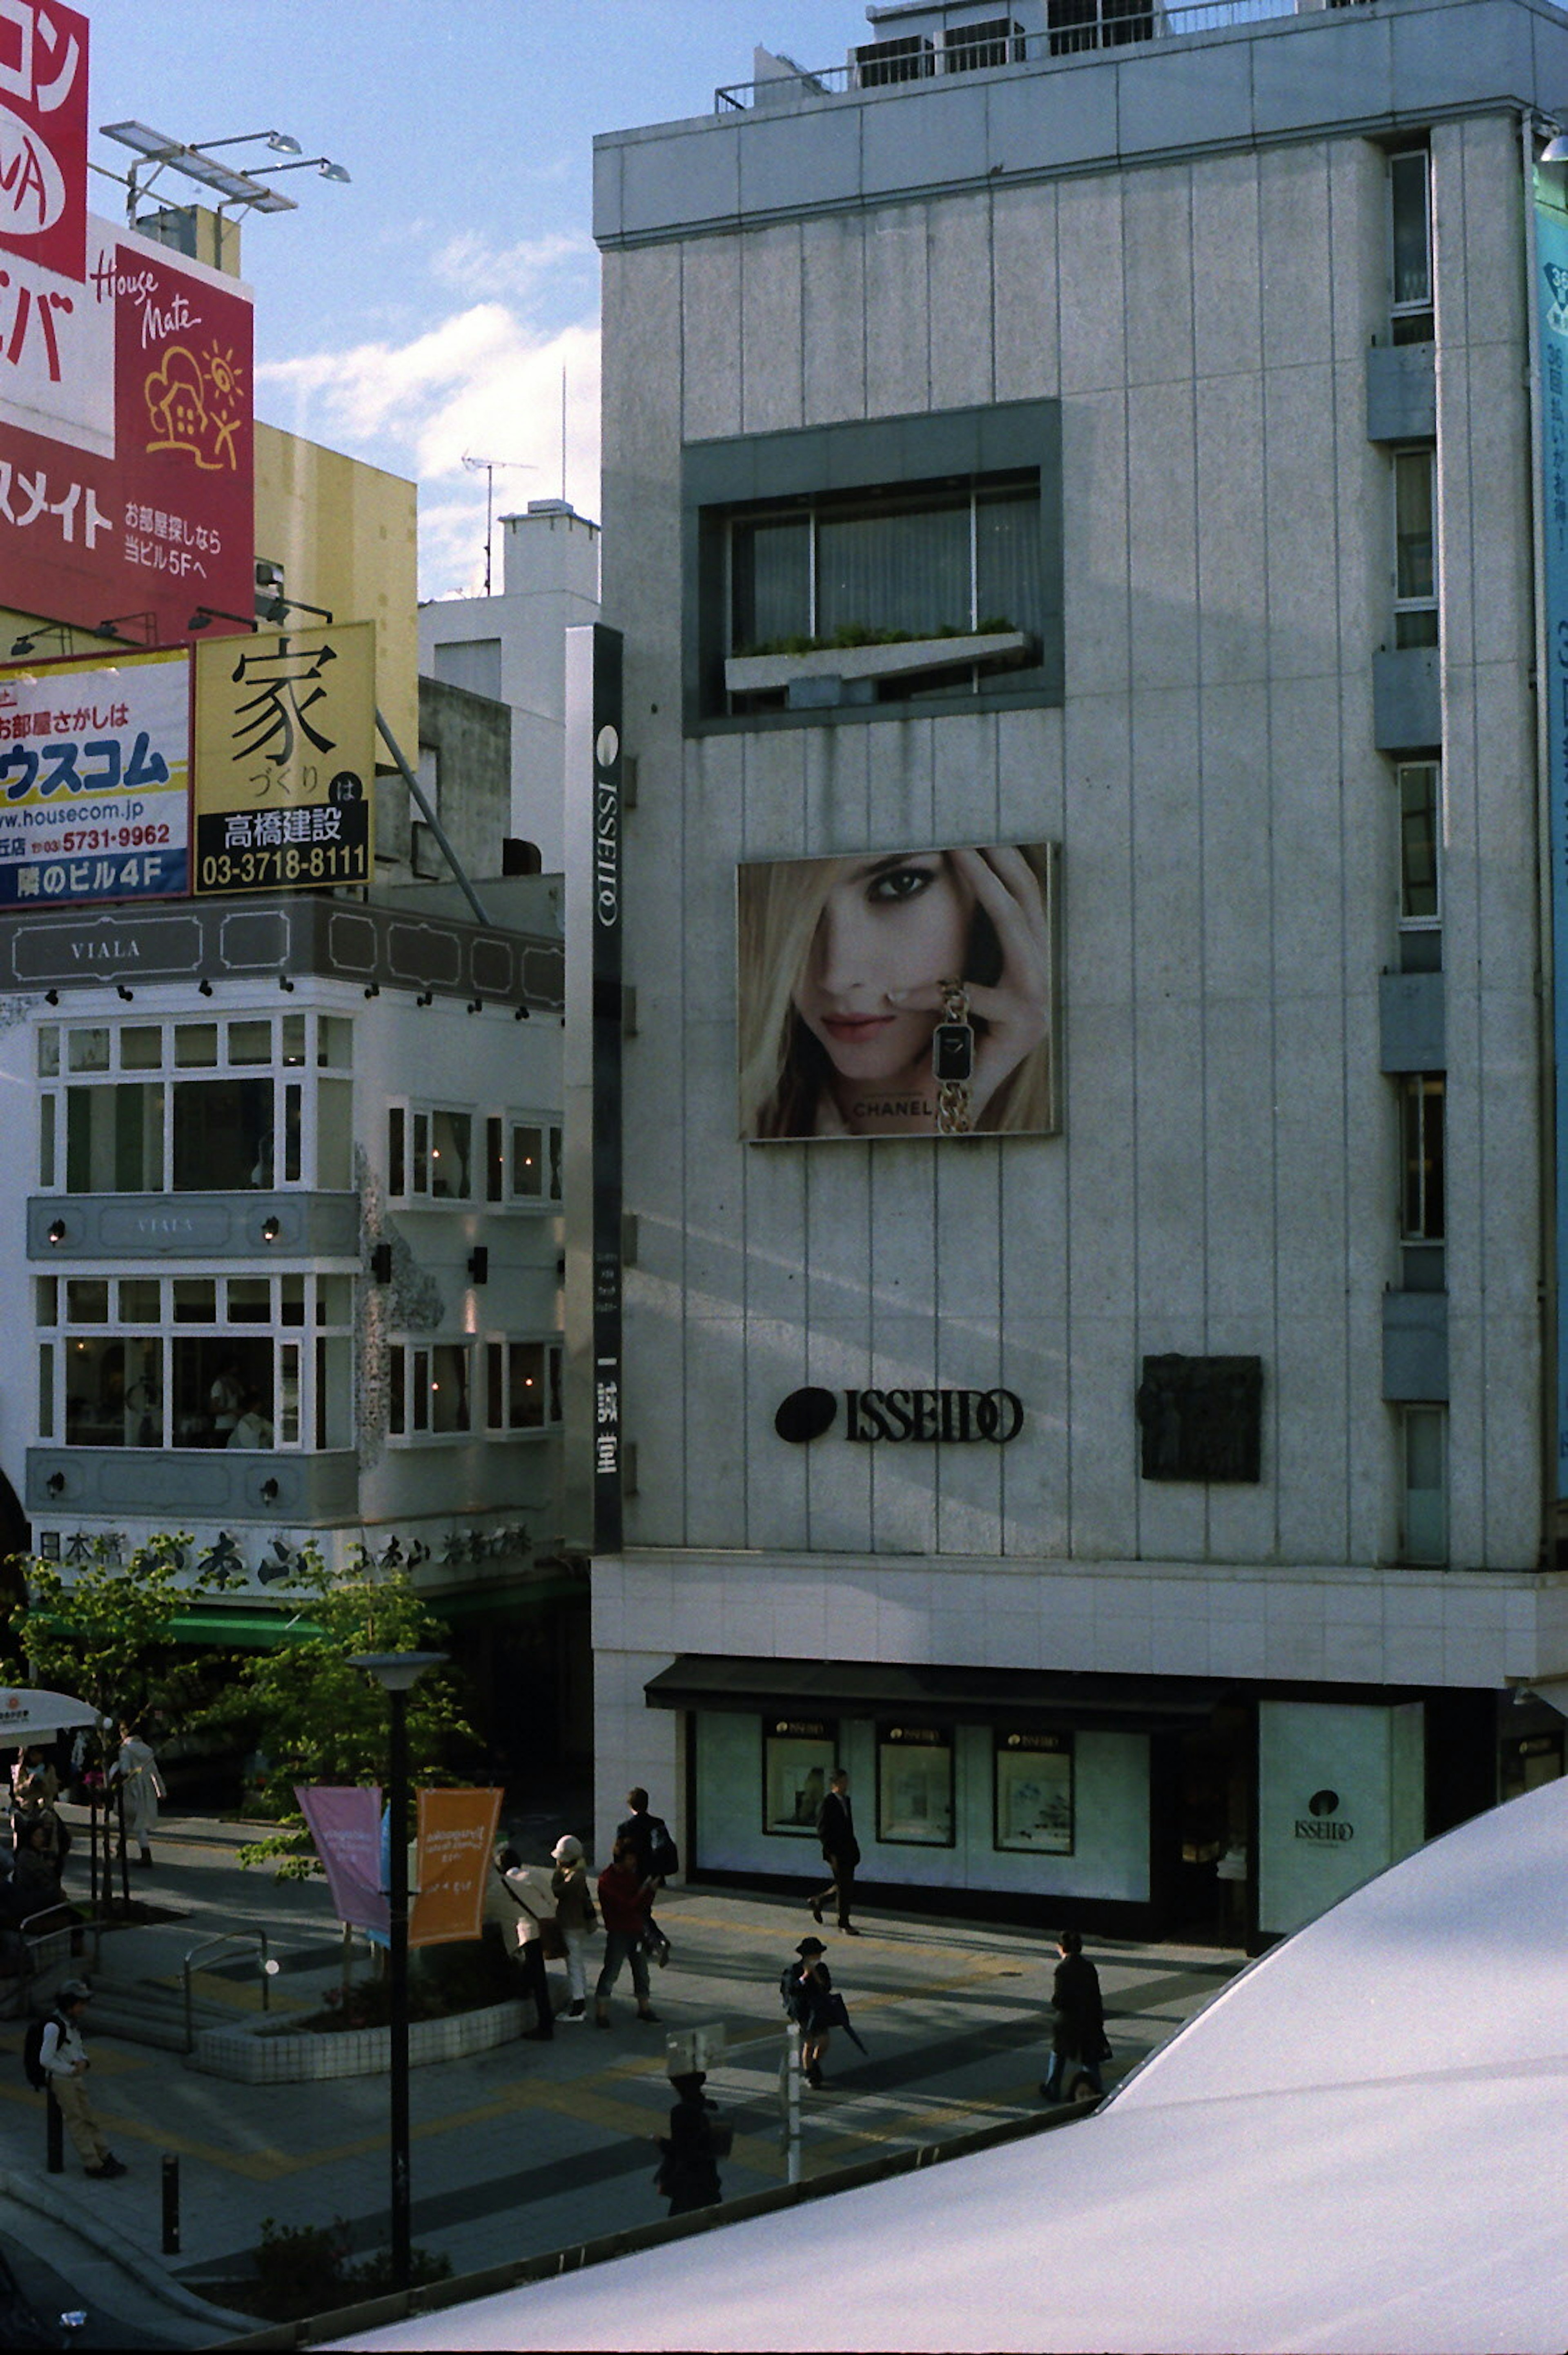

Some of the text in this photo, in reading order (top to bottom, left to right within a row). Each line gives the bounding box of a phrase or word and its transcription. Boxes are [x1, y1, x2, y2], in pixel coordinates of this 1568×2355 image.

[90, 250, 158, 305] House
[0, 270, 73, 381] バ
[142, 293, 202, 349] Mate
[125, 501, 221, 554] お部屋探しなら
[125, 534, 207, 579] 当ビル5Fへ
[0, 702, 129, 740] お部屋さがしは
[232, 638, 337, 765] 家
[225, 807, 342, 849] 高橋建設
[203, 844, 364, 885] 03-3718-8111
[597, 782, 617, 926] ISSEIDO
[71, 940, 140, 959] VIALA
[853, 1099, 932, 1117] CHANEL
[844, 1389, 1023, 1443] ISSEIDO
[1295, 1820, 1354, 1841] ISSEIDO
